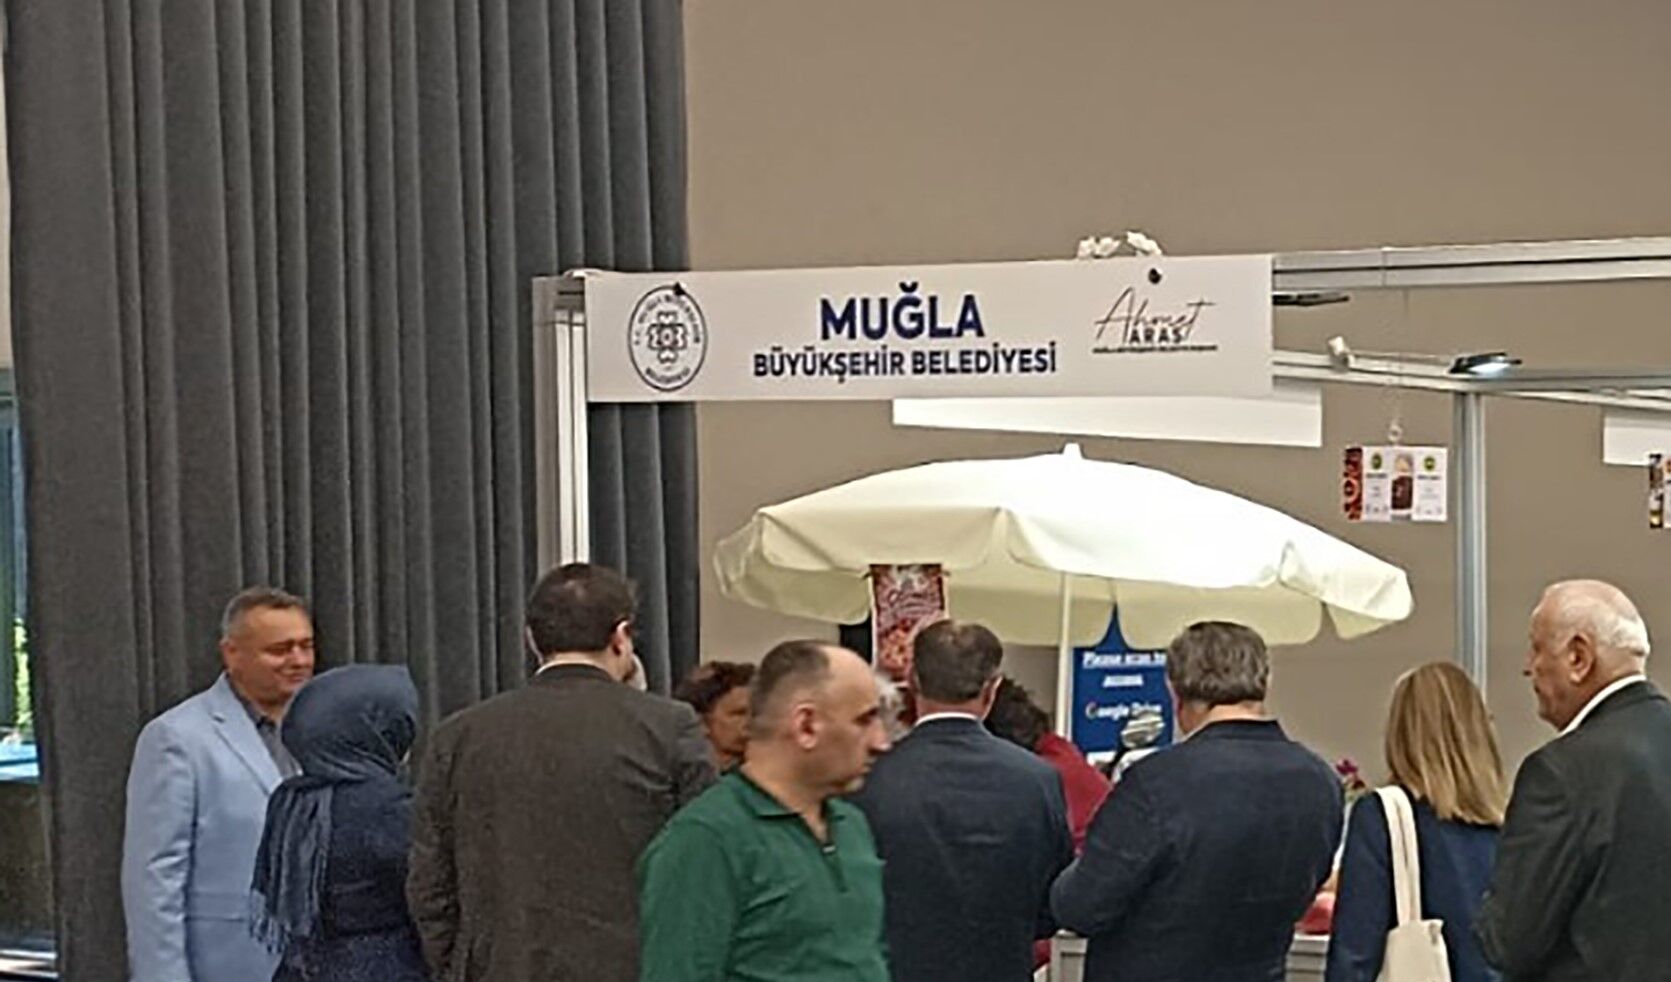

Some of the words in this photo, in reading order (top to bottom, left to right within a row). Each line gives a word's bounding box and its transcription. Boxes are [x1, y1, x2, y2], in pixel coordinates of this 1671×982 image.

[820, 281, 985, 341] MUĞLA
[1128, 326, 1183, 345] ARAS
[753, 346, 905, 384] BÜYÜKŞEHİR
[911, 341, 1057, 376] BELEDİYESİ
